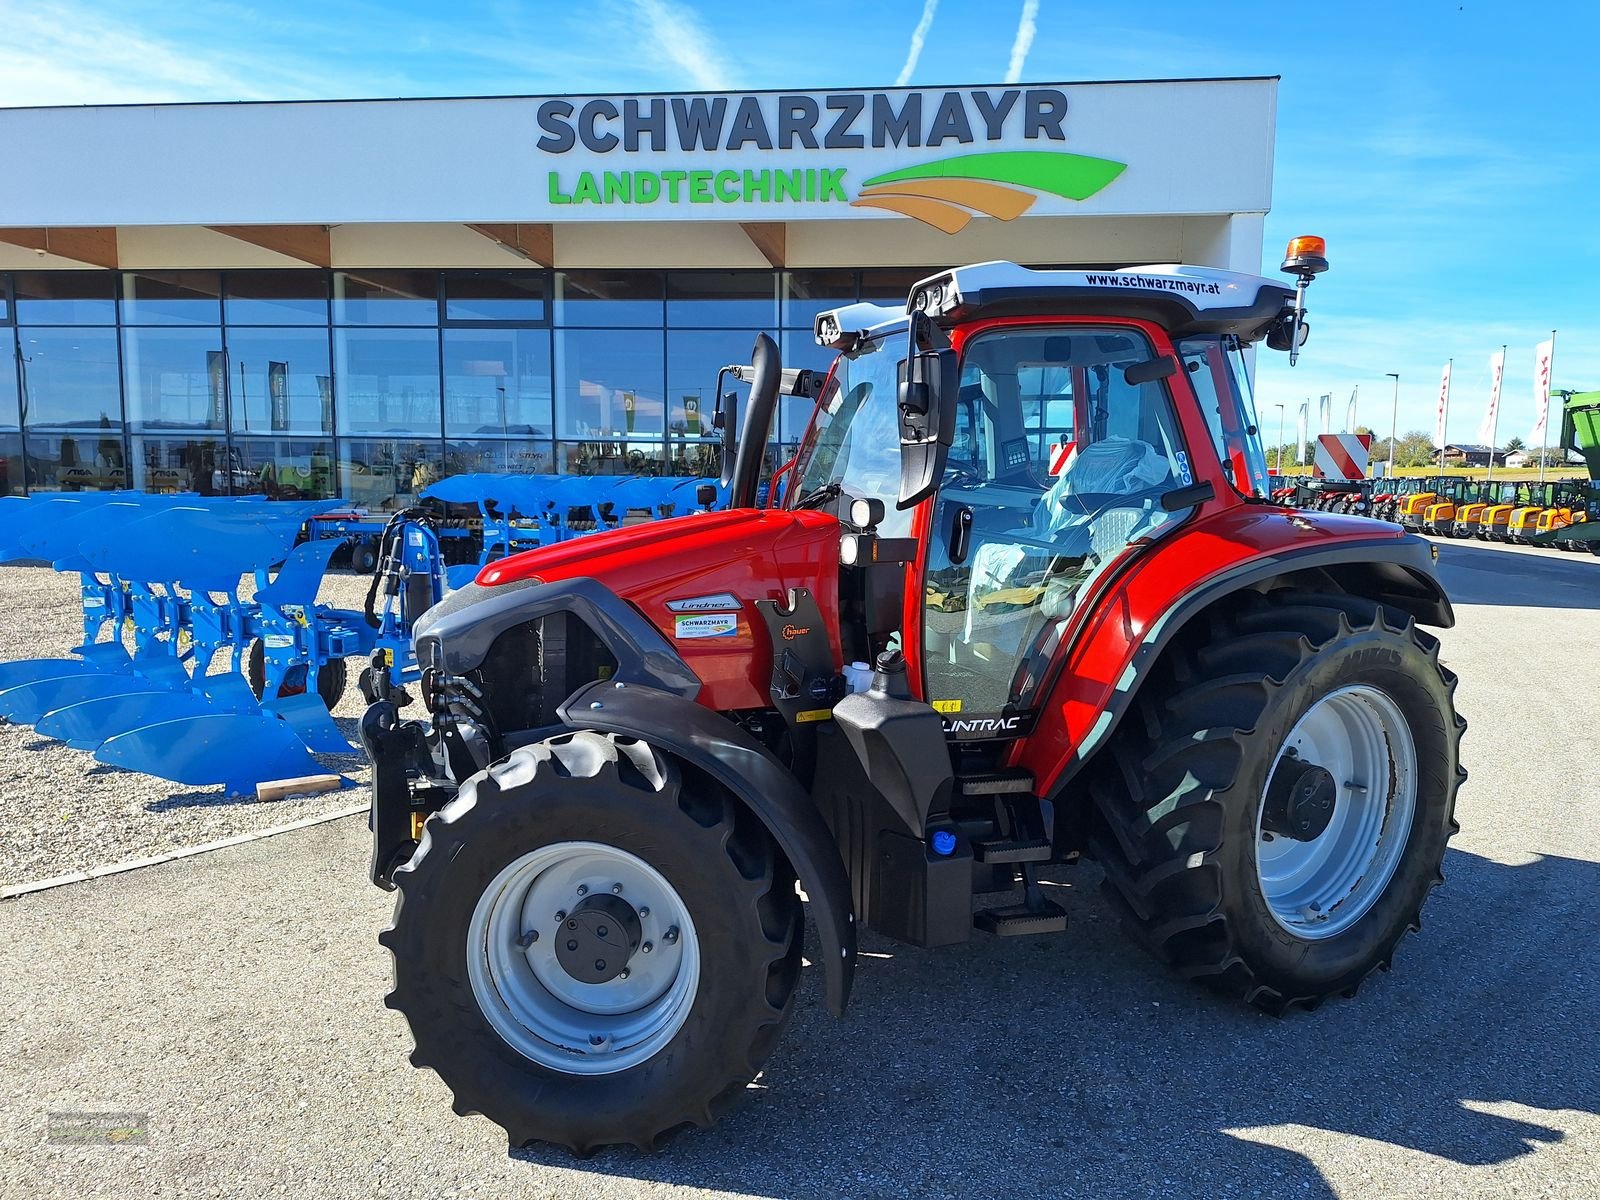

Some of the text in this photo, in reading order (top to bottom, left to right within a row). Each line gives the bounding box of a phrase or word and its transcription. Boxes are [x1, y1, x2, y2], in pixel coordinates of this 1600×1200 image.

[536, 89, 1068, 154] SCHWARZMAYR
[548, 168, 848, 204] LANDTECHNIK
[1086, 274, 1221, 295] www.schwarzmayr.at
[681, 619, 729, 627] SCHWARZMAYR
[786, 627, 811, 636] hauer
